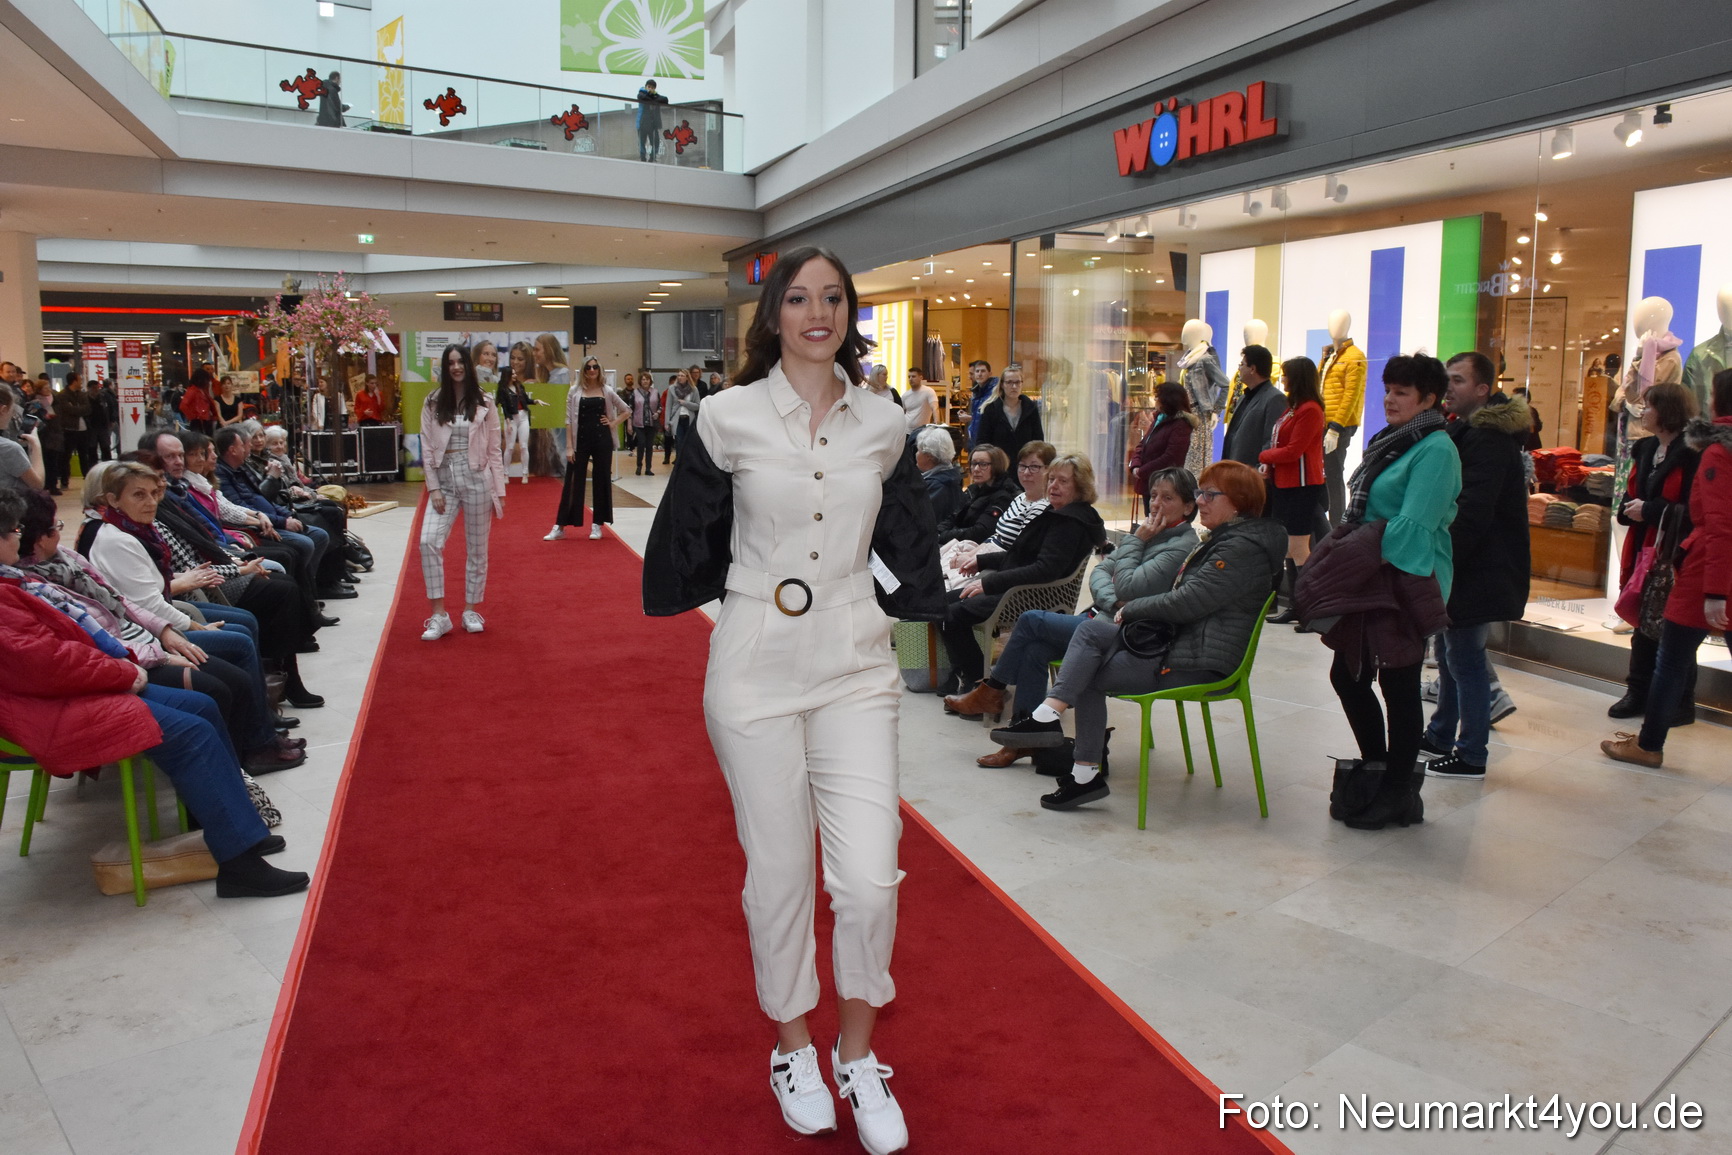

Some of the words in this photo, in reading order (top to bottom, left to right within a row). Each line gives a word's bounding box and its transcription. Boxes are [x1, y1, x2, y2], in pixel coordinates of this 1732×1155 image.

[1113, 81, 1278, 177] WÖHRL
[127, 366, 140, 375] dm
[1536, 596, 1561, 609] AMBER
[1567, 602, 1585, 615] JUNE
